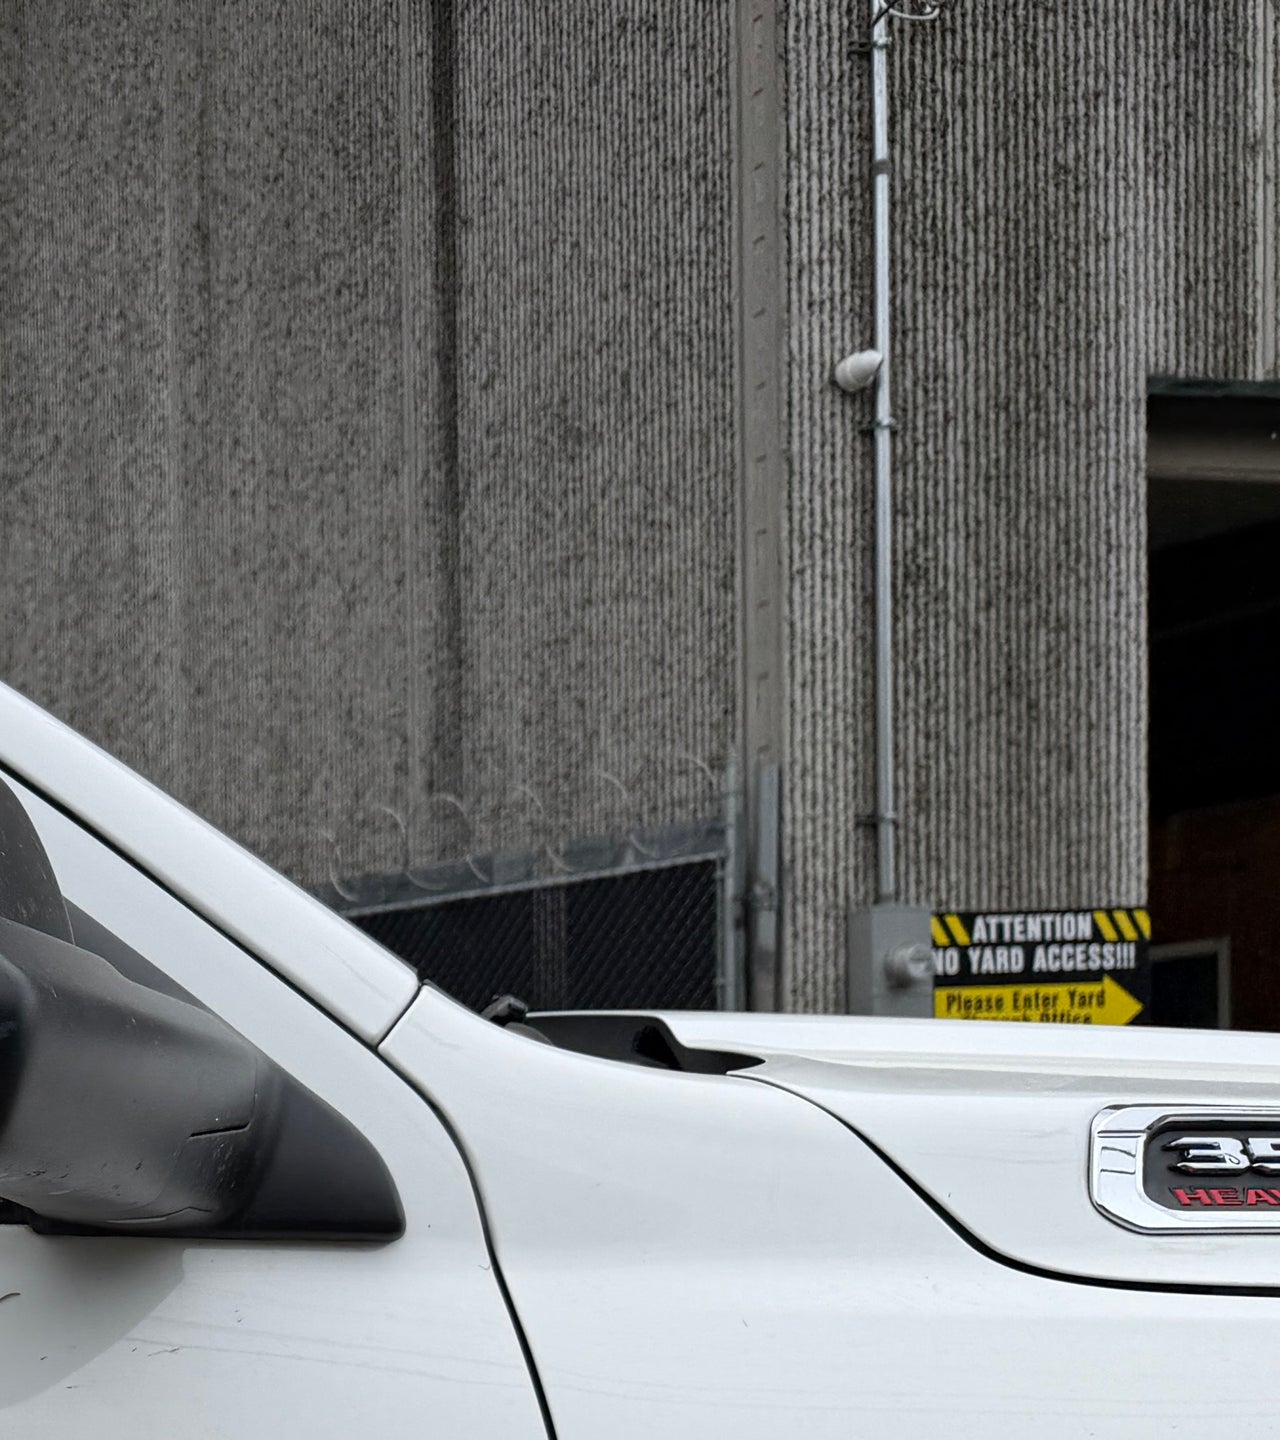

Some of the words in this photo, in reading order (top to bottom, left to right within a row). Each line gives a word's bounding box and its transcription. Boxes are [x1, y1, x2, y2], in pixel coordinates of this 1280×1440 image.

[971, 911, 1093, 943] ATTENTION
[968, 944, 1025, 974] YARD
[1032, 941, 1136, 973] ACCESS!!!
[946, 991, 1005, 1012] Please
[1012, 990, 1059, 1010] Enter
[1068, 988, 1106, 1008] Yard
[1172, 1187, 1280, 1207] HEA
